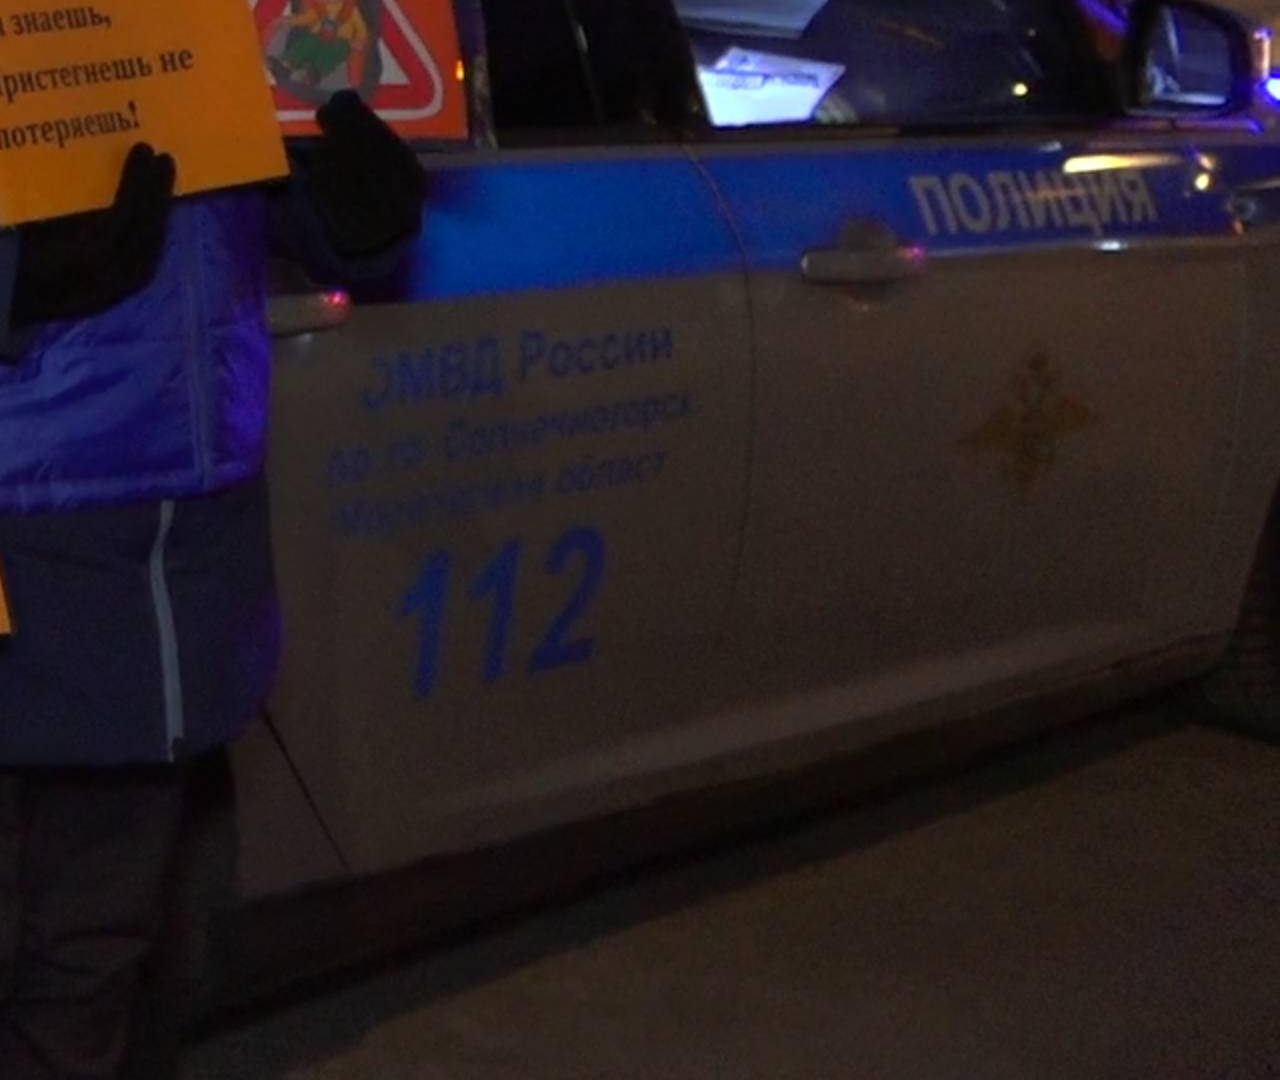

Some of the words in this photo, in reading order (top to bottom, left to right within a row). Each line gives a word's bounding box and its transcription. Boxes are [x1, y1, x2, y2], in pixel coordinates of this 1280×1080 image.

[13, 6, 112, 35] знаешь,
[160, 49, 193, 72] не
[909, 169, 1158, 235] ПОЛИЦИЯ
[519, 328, 674, 381] России
[398, 523, 606, 702] 112
